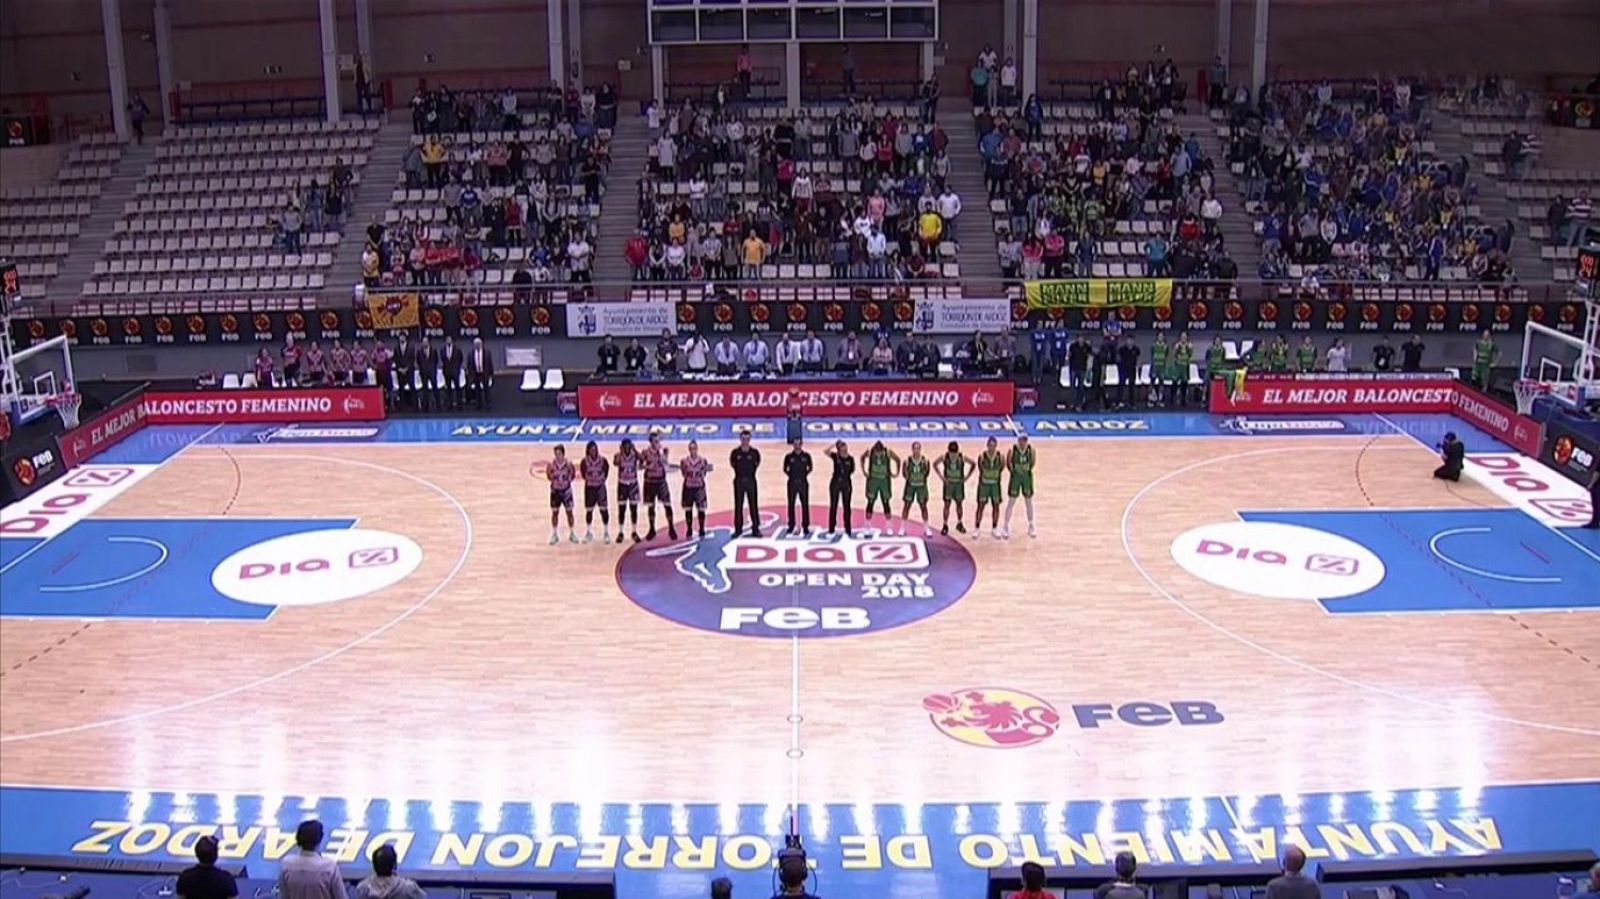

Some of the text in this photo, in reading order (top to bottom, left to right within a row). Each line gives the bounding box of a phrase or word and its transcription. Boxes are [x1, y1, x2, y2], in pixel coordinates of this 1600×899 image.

[1042, 283, 1087, 294] MANN
[1109, 282, 1154, 293] MANN
[633, 393, 658, 408] EL
[660, 392, 724, 408] MEJOR
[859, 389, 959, 406] FEMENINO
[1263, 389, 1288, 404] EL
[1290, 388, 1347, 404] MEJOR
[1353, 387, 1459, 404] BALONCESTO
[1458, 396, 1509, 432] FEMENINO
[91, 431, 103, 446] EL
[105, 410, 137, 437] MEJOR
[138, 399, 238, 421] BALONCESTO
[240, 397, 332, 415] FEMENINO
[451, 418, 1150, 436] AYUNTAMIENTO DE ORREJON DE ARDOZ
[759, 572, 930, 587] OPEN DAY
[861, 584, 934, 598] 2018
[71, 820, 304, 860] ARDOZ
[958, 817, 1503, 868] AYUNTAMIENTO
[839, 834, 933, 869] DE
